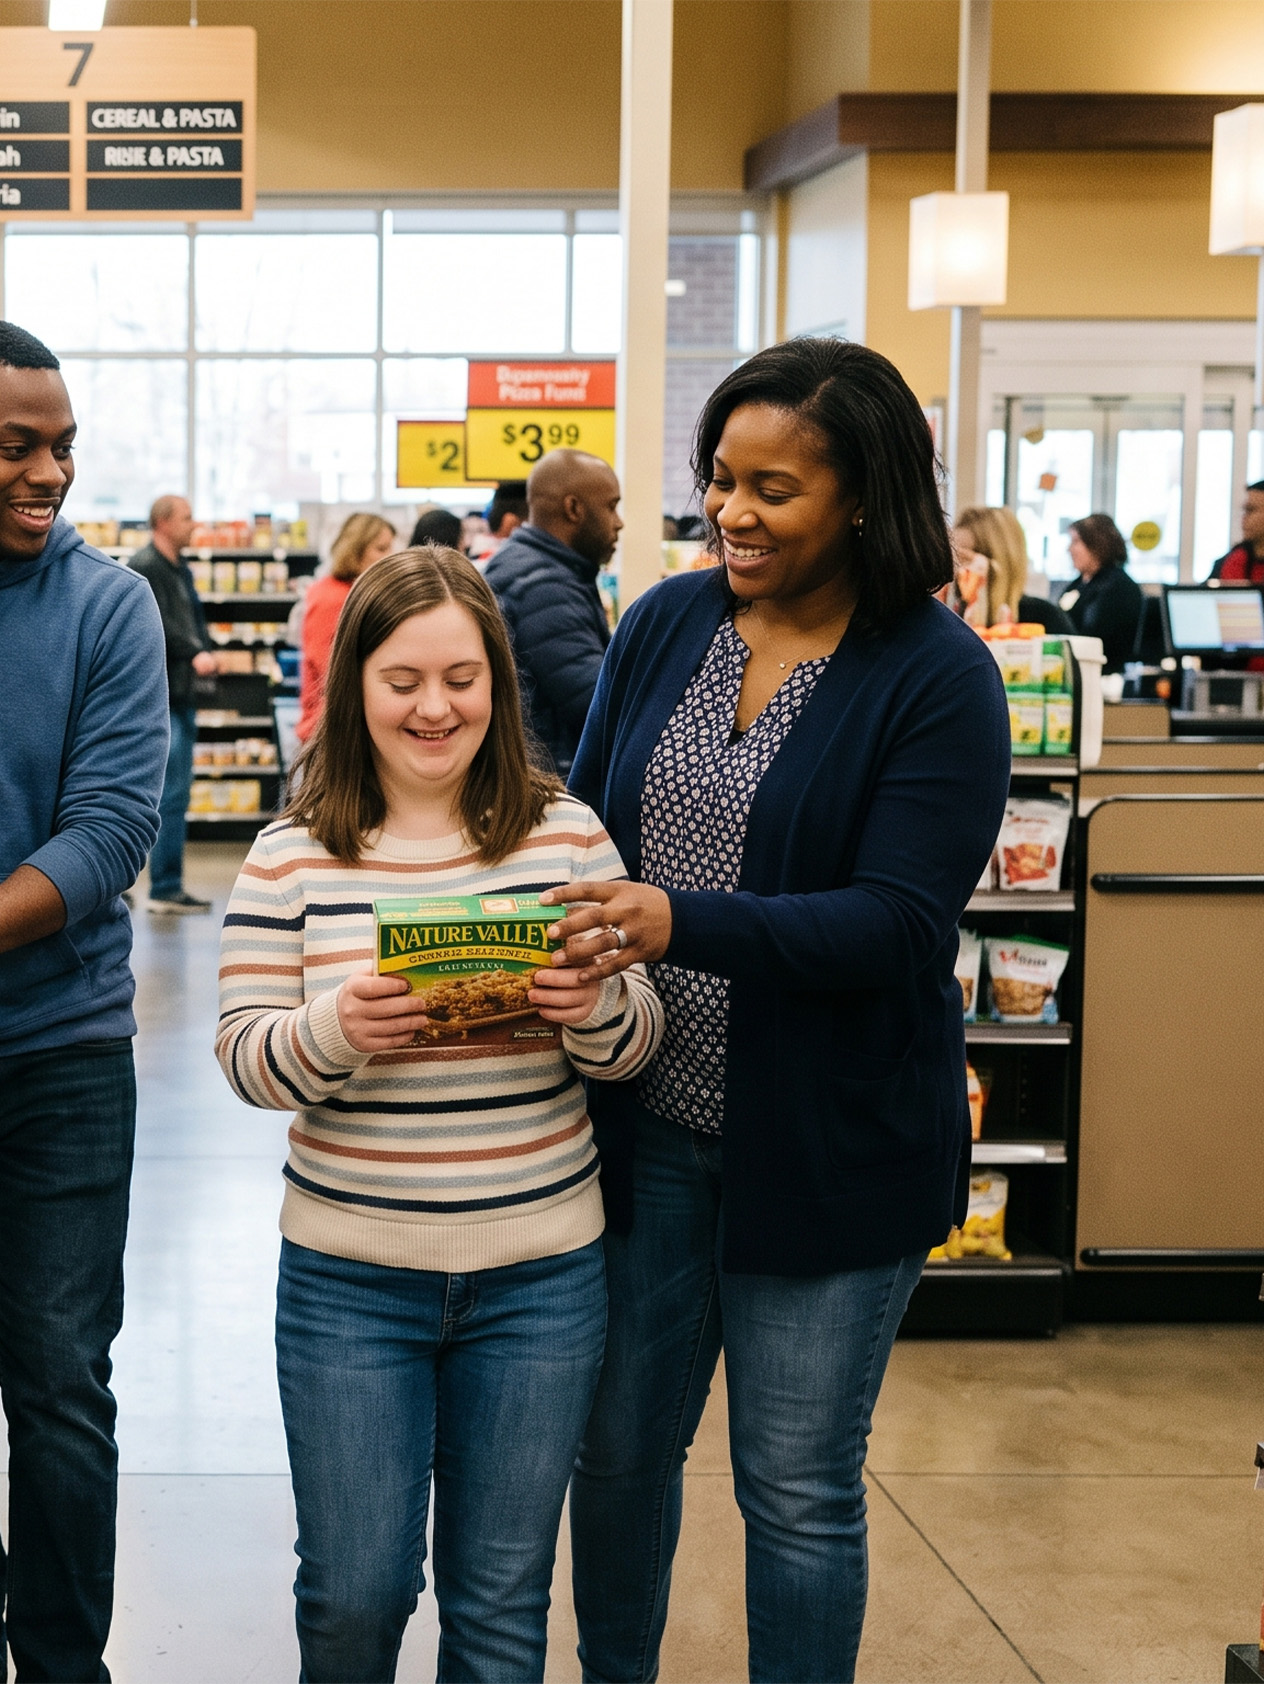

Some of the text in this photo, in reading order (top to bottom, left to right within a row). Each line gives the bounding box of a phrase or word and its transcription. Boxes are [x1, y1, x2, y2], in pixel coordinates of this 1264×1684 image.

[63, 42, 95, 87] 7
[91, 108, 237, 129] CEREAL & PASTA
[148, 147, 166, 167] &
[166, 147, 225, 167] PASTA
[389, 923, 550, 955] NATURE VALLEY
